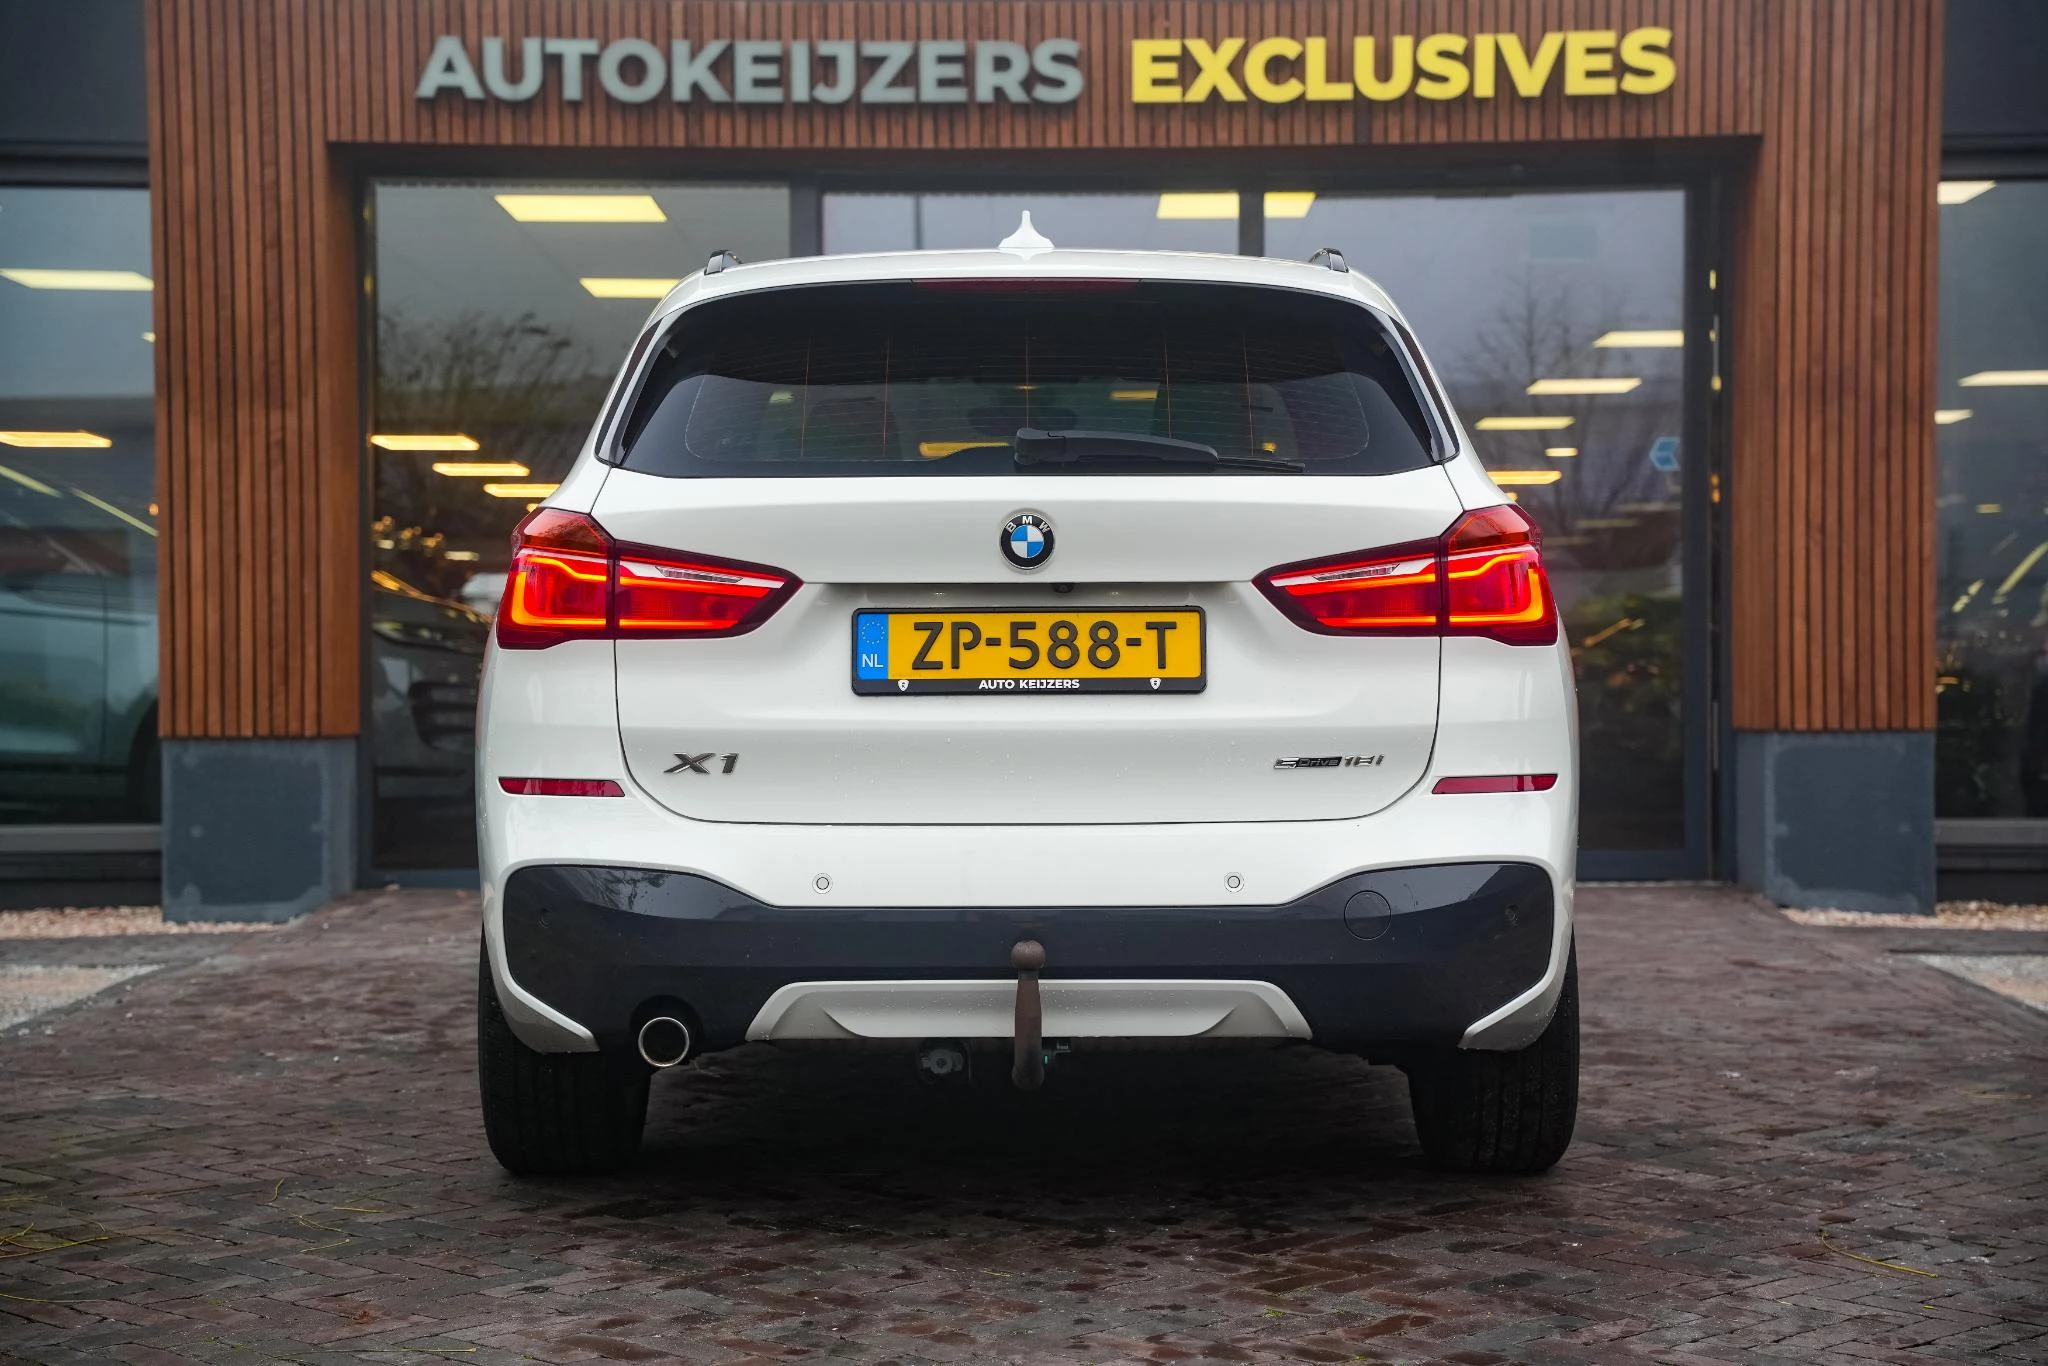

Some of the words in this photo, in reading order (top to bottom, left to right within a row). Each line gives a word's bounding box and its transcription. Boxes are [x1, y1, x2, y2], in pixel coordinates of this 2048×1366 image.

[1131, 27, 1677, 103] EXCLUSIVES
[1005, 515, 1051, 533] BMW
[912, 619, 1178, 671] ZP-588-T
[862, 654, 884, 668] NL
[978, 679, 1016, 690] AUTO
[1019, 678, 1081, 689] KEIJZERS
[663, 752, 740, 774] X1
